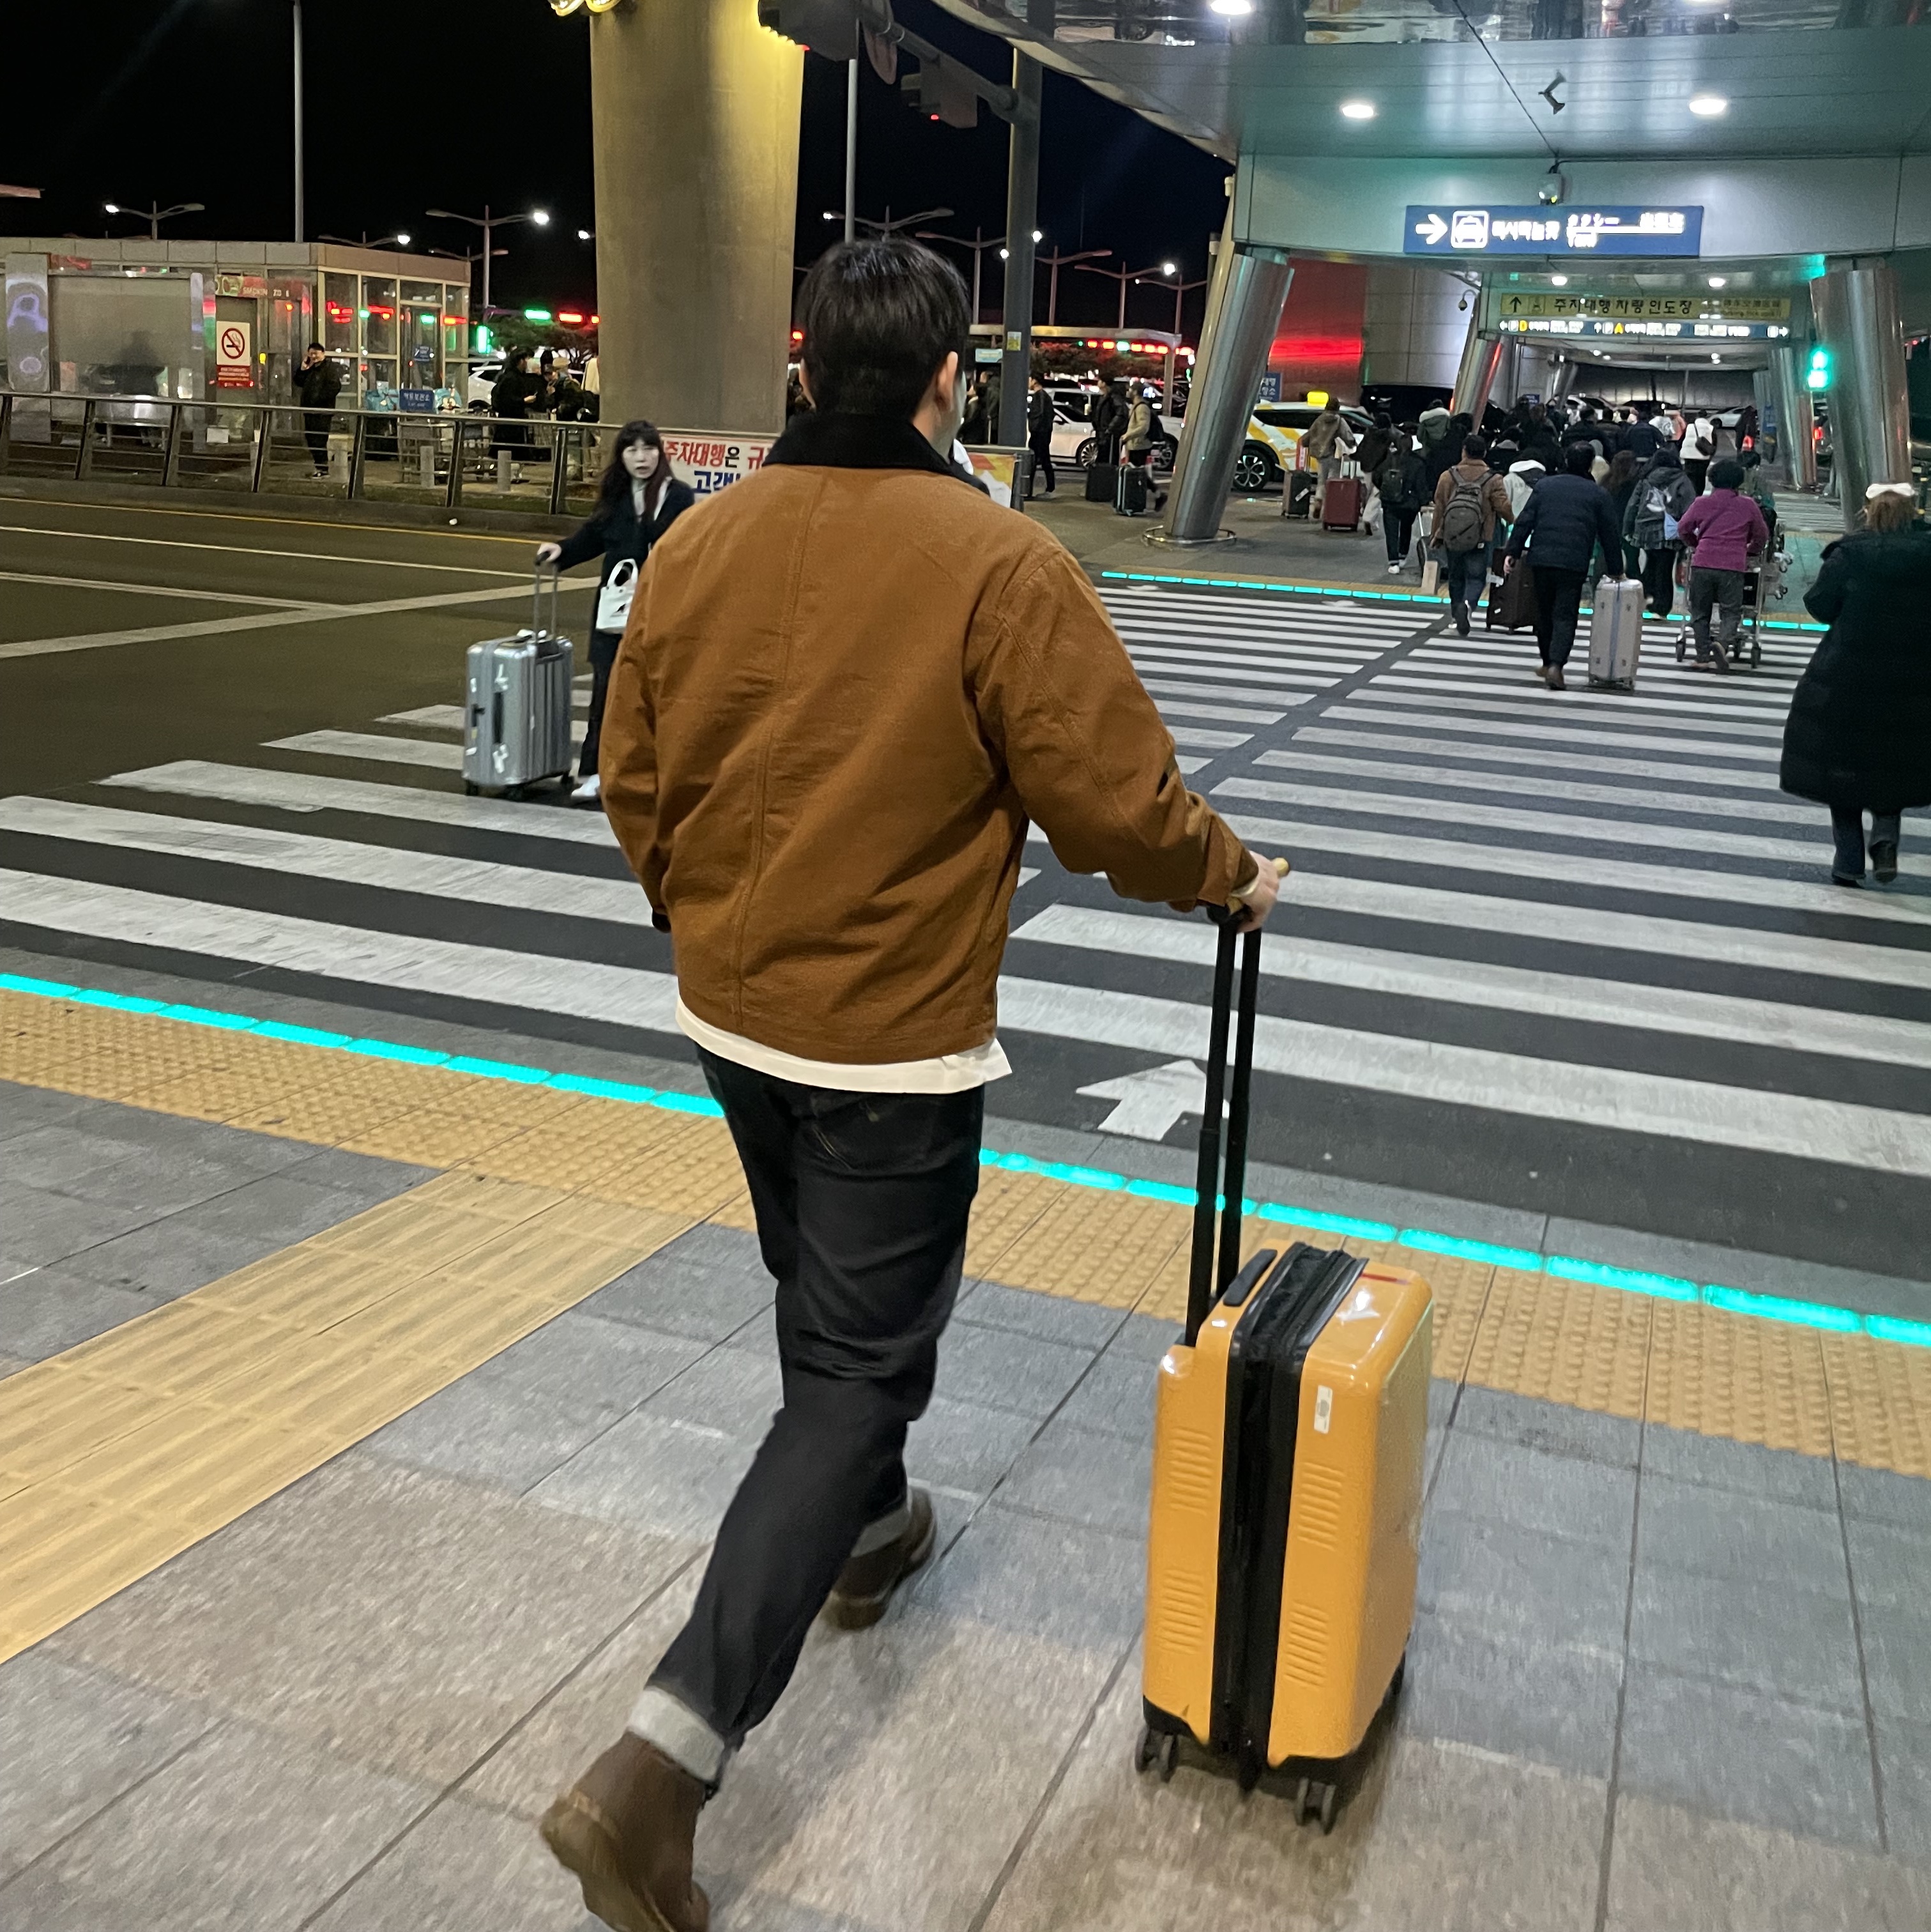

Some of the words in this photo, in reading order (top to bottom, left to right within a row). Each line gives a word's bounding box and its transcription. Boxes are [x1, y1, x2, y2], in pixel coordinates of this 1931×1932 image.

[1649, 300, 1692, 314] 인도장
[666, 441, 740, 468] 주차대행은
[692, 470, 741, 494] 고객
